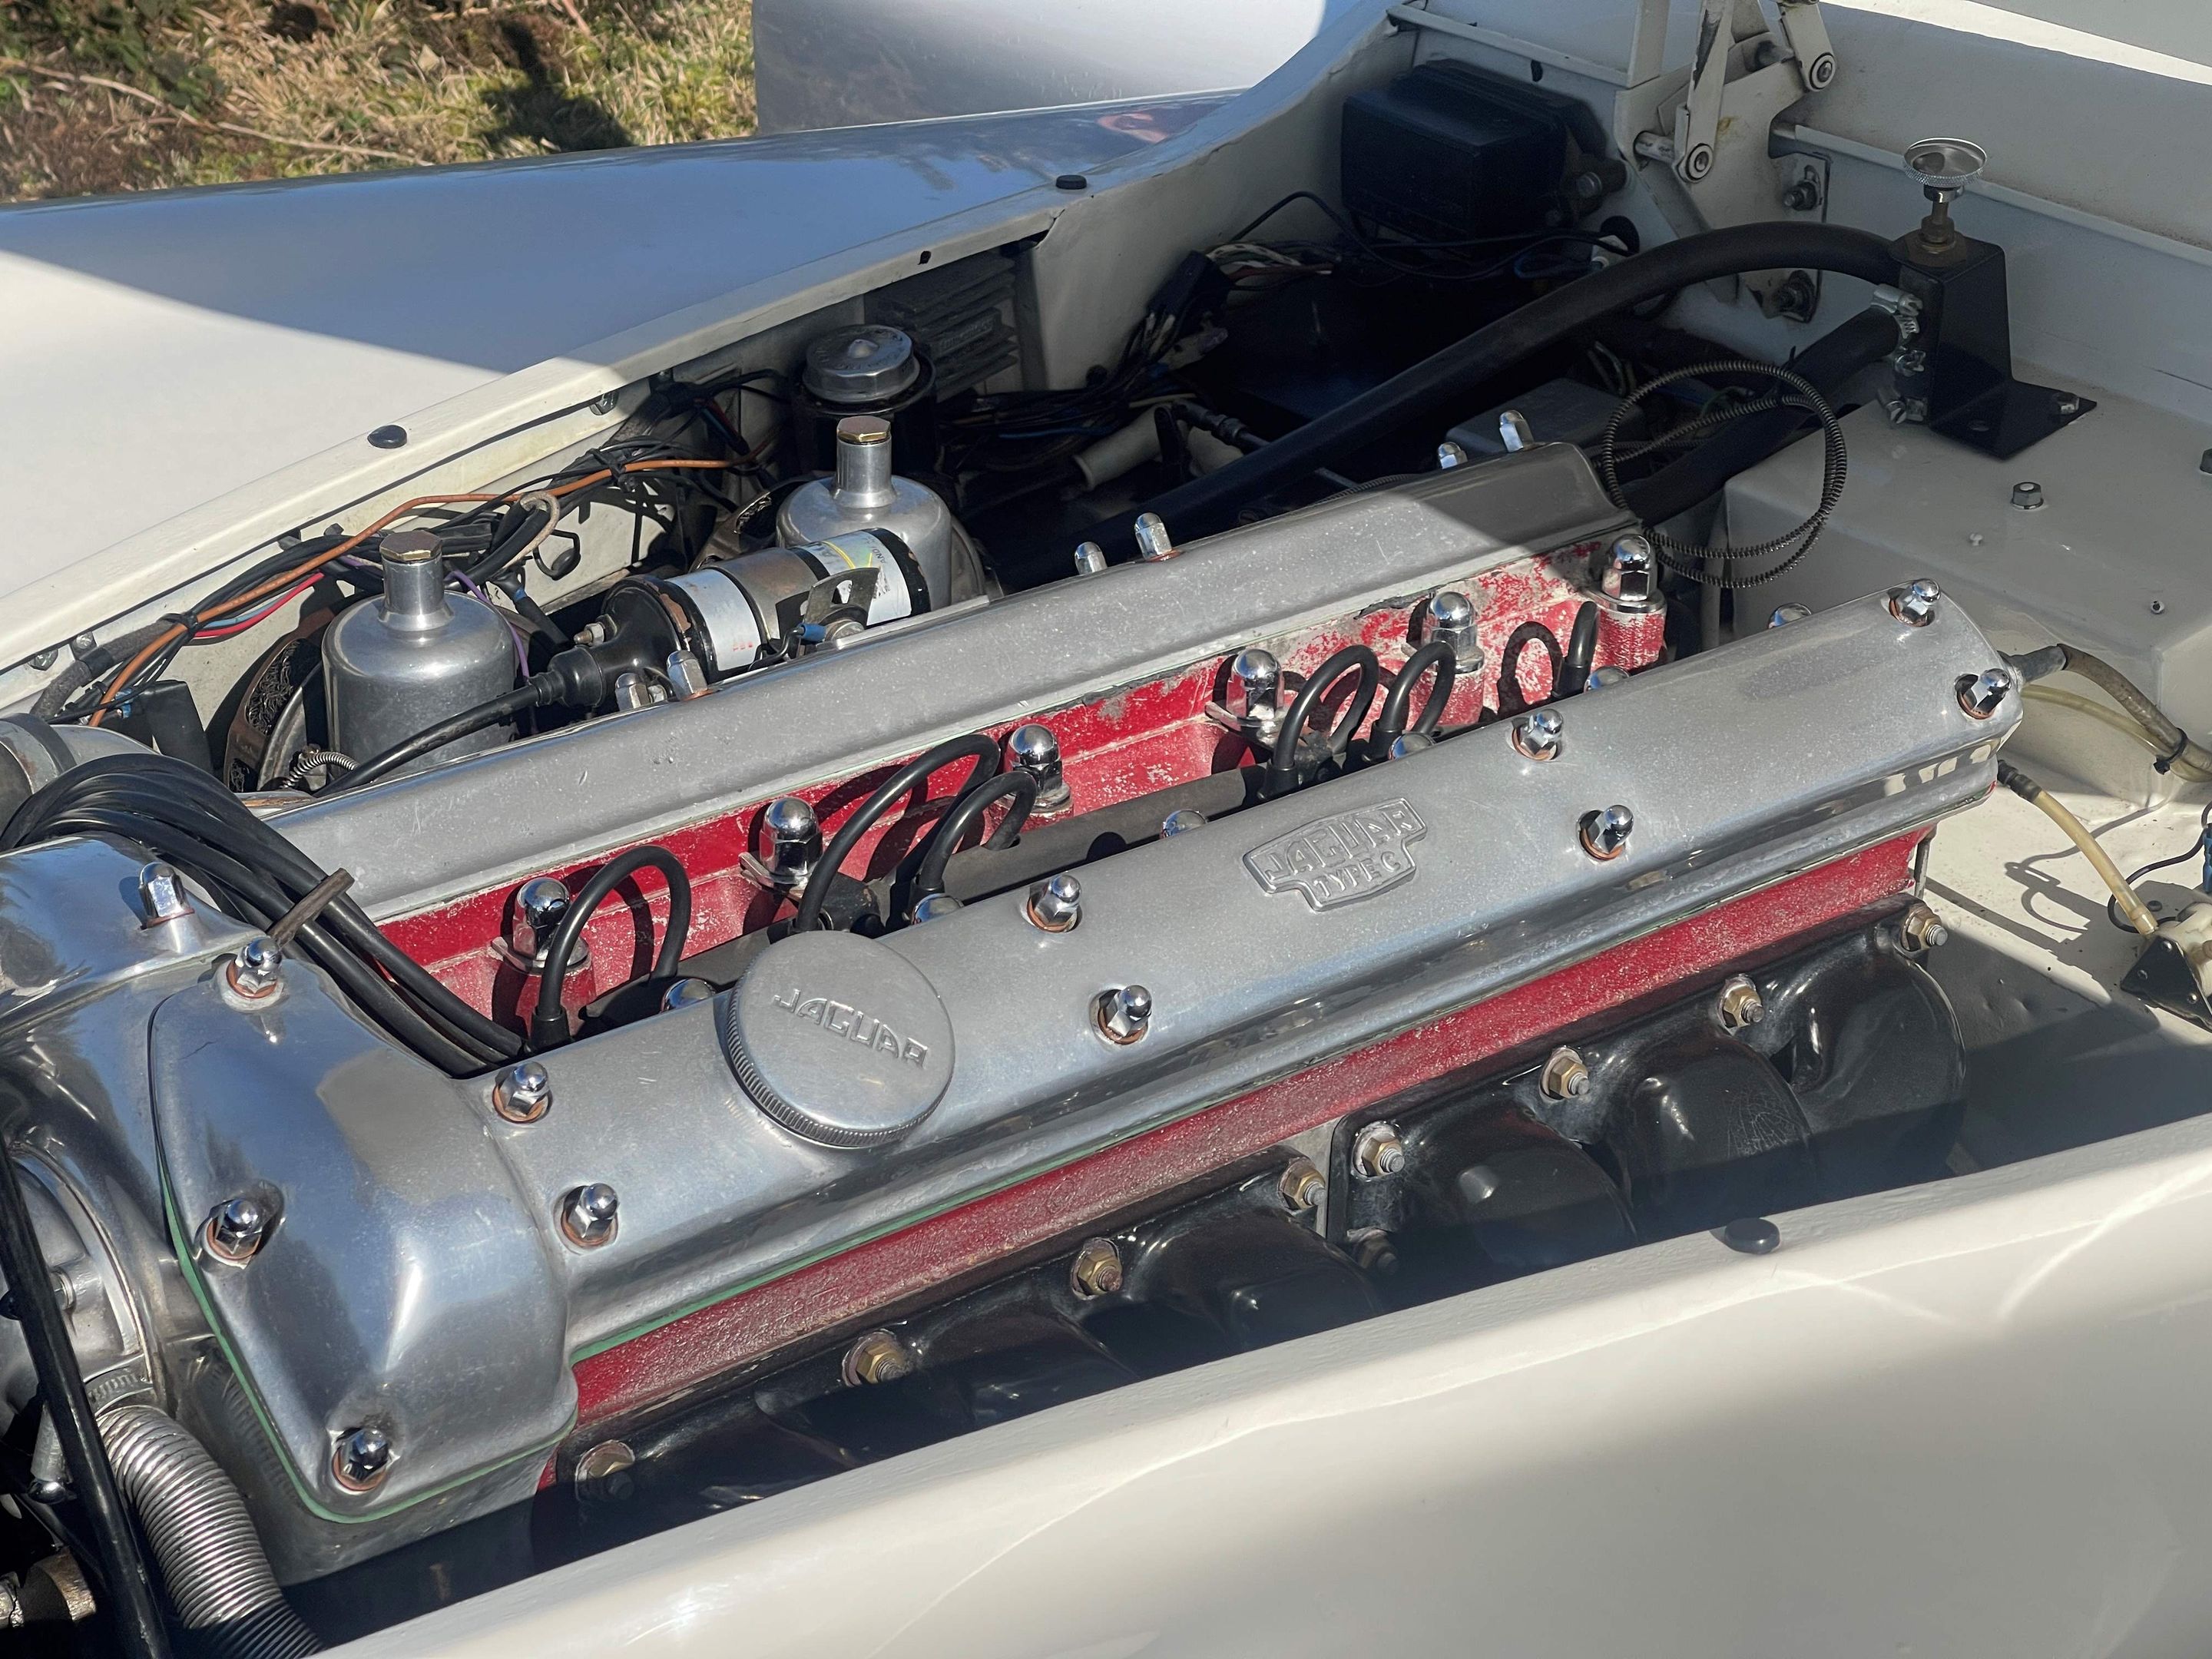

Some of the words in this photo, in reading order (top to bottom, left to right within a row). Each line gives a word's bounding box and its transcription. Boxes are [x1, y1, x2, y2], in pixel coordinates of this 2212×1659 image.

[1264, 810, 1415, 881] JAGUAR
[1313, 857, 1382, 897] TYPE
[1381, 851, 1400, 872] C
[773, 988, 928, 1068] JAGUAR
